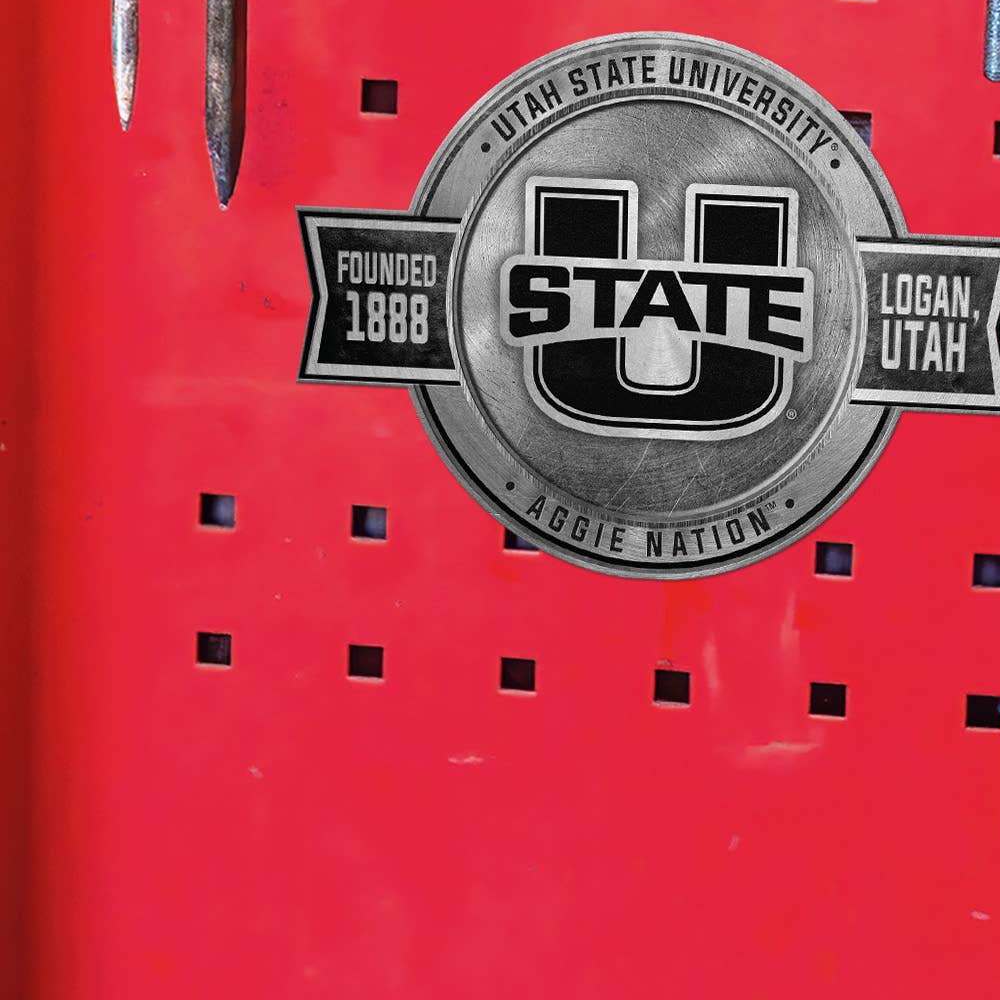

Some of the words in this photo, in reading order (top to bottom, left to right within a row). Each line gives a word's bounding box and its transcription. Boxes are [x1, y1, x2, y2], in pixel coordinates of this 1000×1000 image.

[490, 79, 563, 142] UTAH
[568, 55, 656, 97] STATE
[337, 250, 437, 288] FOUNDED
[346, 290, 429, 345] 1888
[508, 263, 805, 353] STATE
[880, 272, 980, 328] LOGAN,
[881, 319, 967, 373] UTAH
[526, 494, 626, 553] AGGIE
